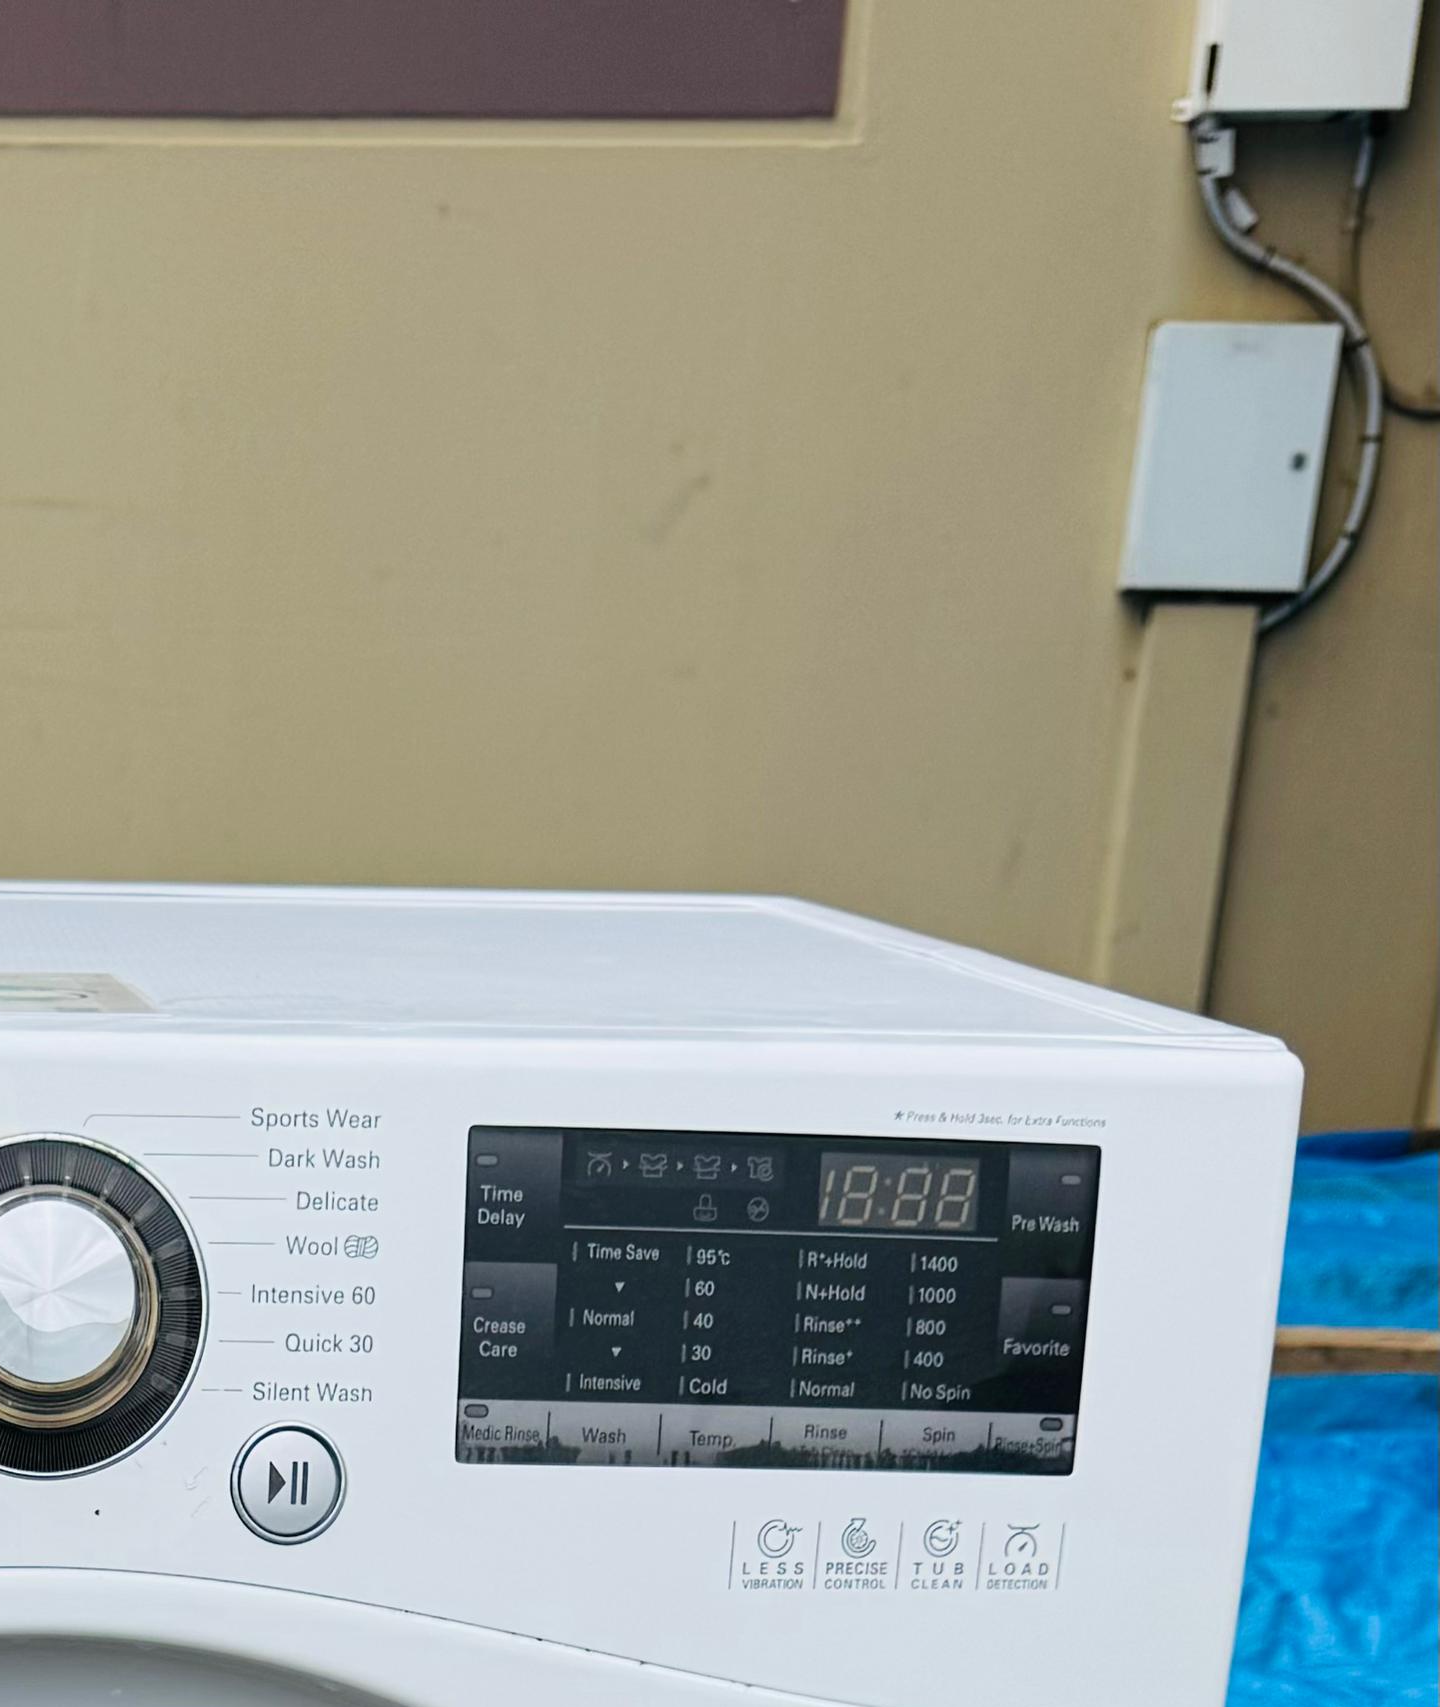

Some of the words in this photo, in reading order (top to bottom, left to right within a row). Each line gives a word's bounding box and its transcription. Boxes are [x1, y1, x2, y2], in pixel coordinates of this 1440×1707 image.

[251, 1108, 320, 1132] Sports
[327, 1108, 382, 1130] Wear
[268, 1148, 316, 1169] Dark
[322, 1149, 381, 1171] Wash
[295, 1191, 379, 1212] Delicate
[480, 1185, 523, 1202] Time
[477, 1209, 525, 1228] Delay
[1012, 1214, 1036, 1232] Pre
[1039, 1216, 1080, 1232] Wash
[286, 1236, 340, 1258] Wool
[587, 1243, 622, 1260] Time
[626, 1244, 659, 1261] Save
[920, 1256, 958, 1272] 1400
[251, 1284, 345, 1307] Intensive
[351, 1285, 376, 1306] 60
[694, 1281, 715, 1296] 60
[806, 1284, 866, 1301] N+Hold
[918, 1288, 956, 1304] 1000
[473, 1317, 526, 1333] Crease
[582, 1309, 635, 1326] Normal
[693, 1313, 713, 1329] 40
[916, 1320, 946, 1336] 800
[284, 1332, 342, 1354] Quick
[349, 1334, 374, 1354] 30
[479, 1340, 518, 1357] Care
[1003, 1338, 1070, 1356] Favorite
[691, 1345, 711, 1361] 30
[913, 1352, 944, 1368] 400
[579, 1374, 641, 1391] Intensive
[689, 1378, 728, 1395] Cold
[799, 1381, 855, 1397] Normal
[252, 1381, 309, 1403] Silent
[314, 1382, 373, 1403] Wash
[910, 1383, 932, 1399] No
[936, 1384, 970, 1402] Spin
[462, 1424, 501, 1442] Medic
[504, 1426, 540, 1443] Rinse
[582, 1427, 626, 1445] Wash
[805, 1424, 847, 1441] Rinse
[923, 1428, 955, 1445] Spin
[826, 1562, 888, 1575] PRECISE
[742, 1578, 803, 1589] VIBRATION
[824, 1578, 886, 1590] CONTROL
[911, 1579, 963, 1590] CLEAN
[987, 1579, 1048, 1590] DETECTION
